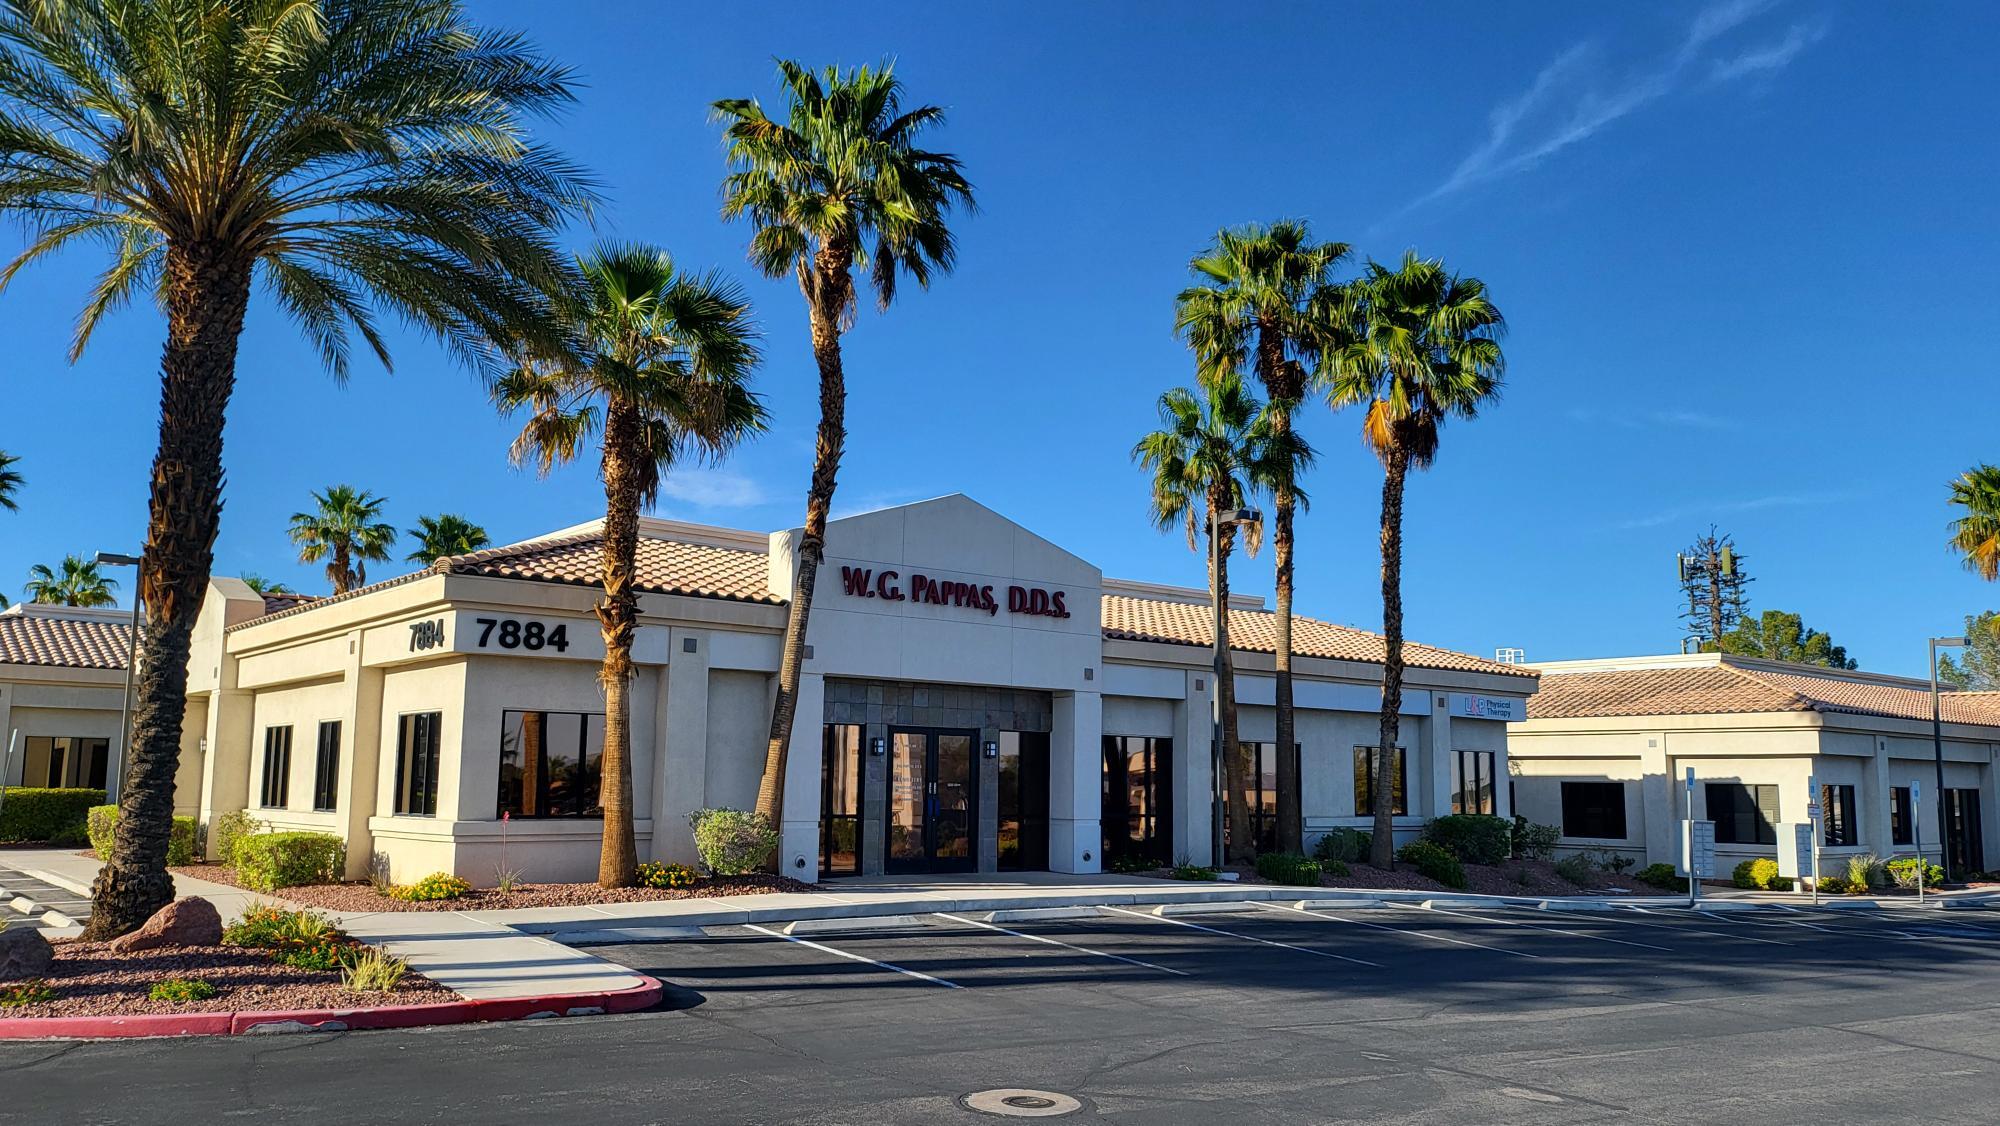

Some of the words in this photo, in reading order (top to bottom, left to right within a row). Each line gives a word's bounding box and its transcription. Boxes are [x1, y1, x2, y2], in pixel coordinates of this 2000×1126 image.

[841, 566, 905, 601] W.G.
[911, 574, 999, 617] PAPPAS,
[1008, 585, 1071, 618] D.D.S.
[409, 618, 445, 652] 7884
[476, 618, 569, 652] 7884
[1486, 700, 1511, 709] Physical
[1487, 708, 1511, 718] Therapy
